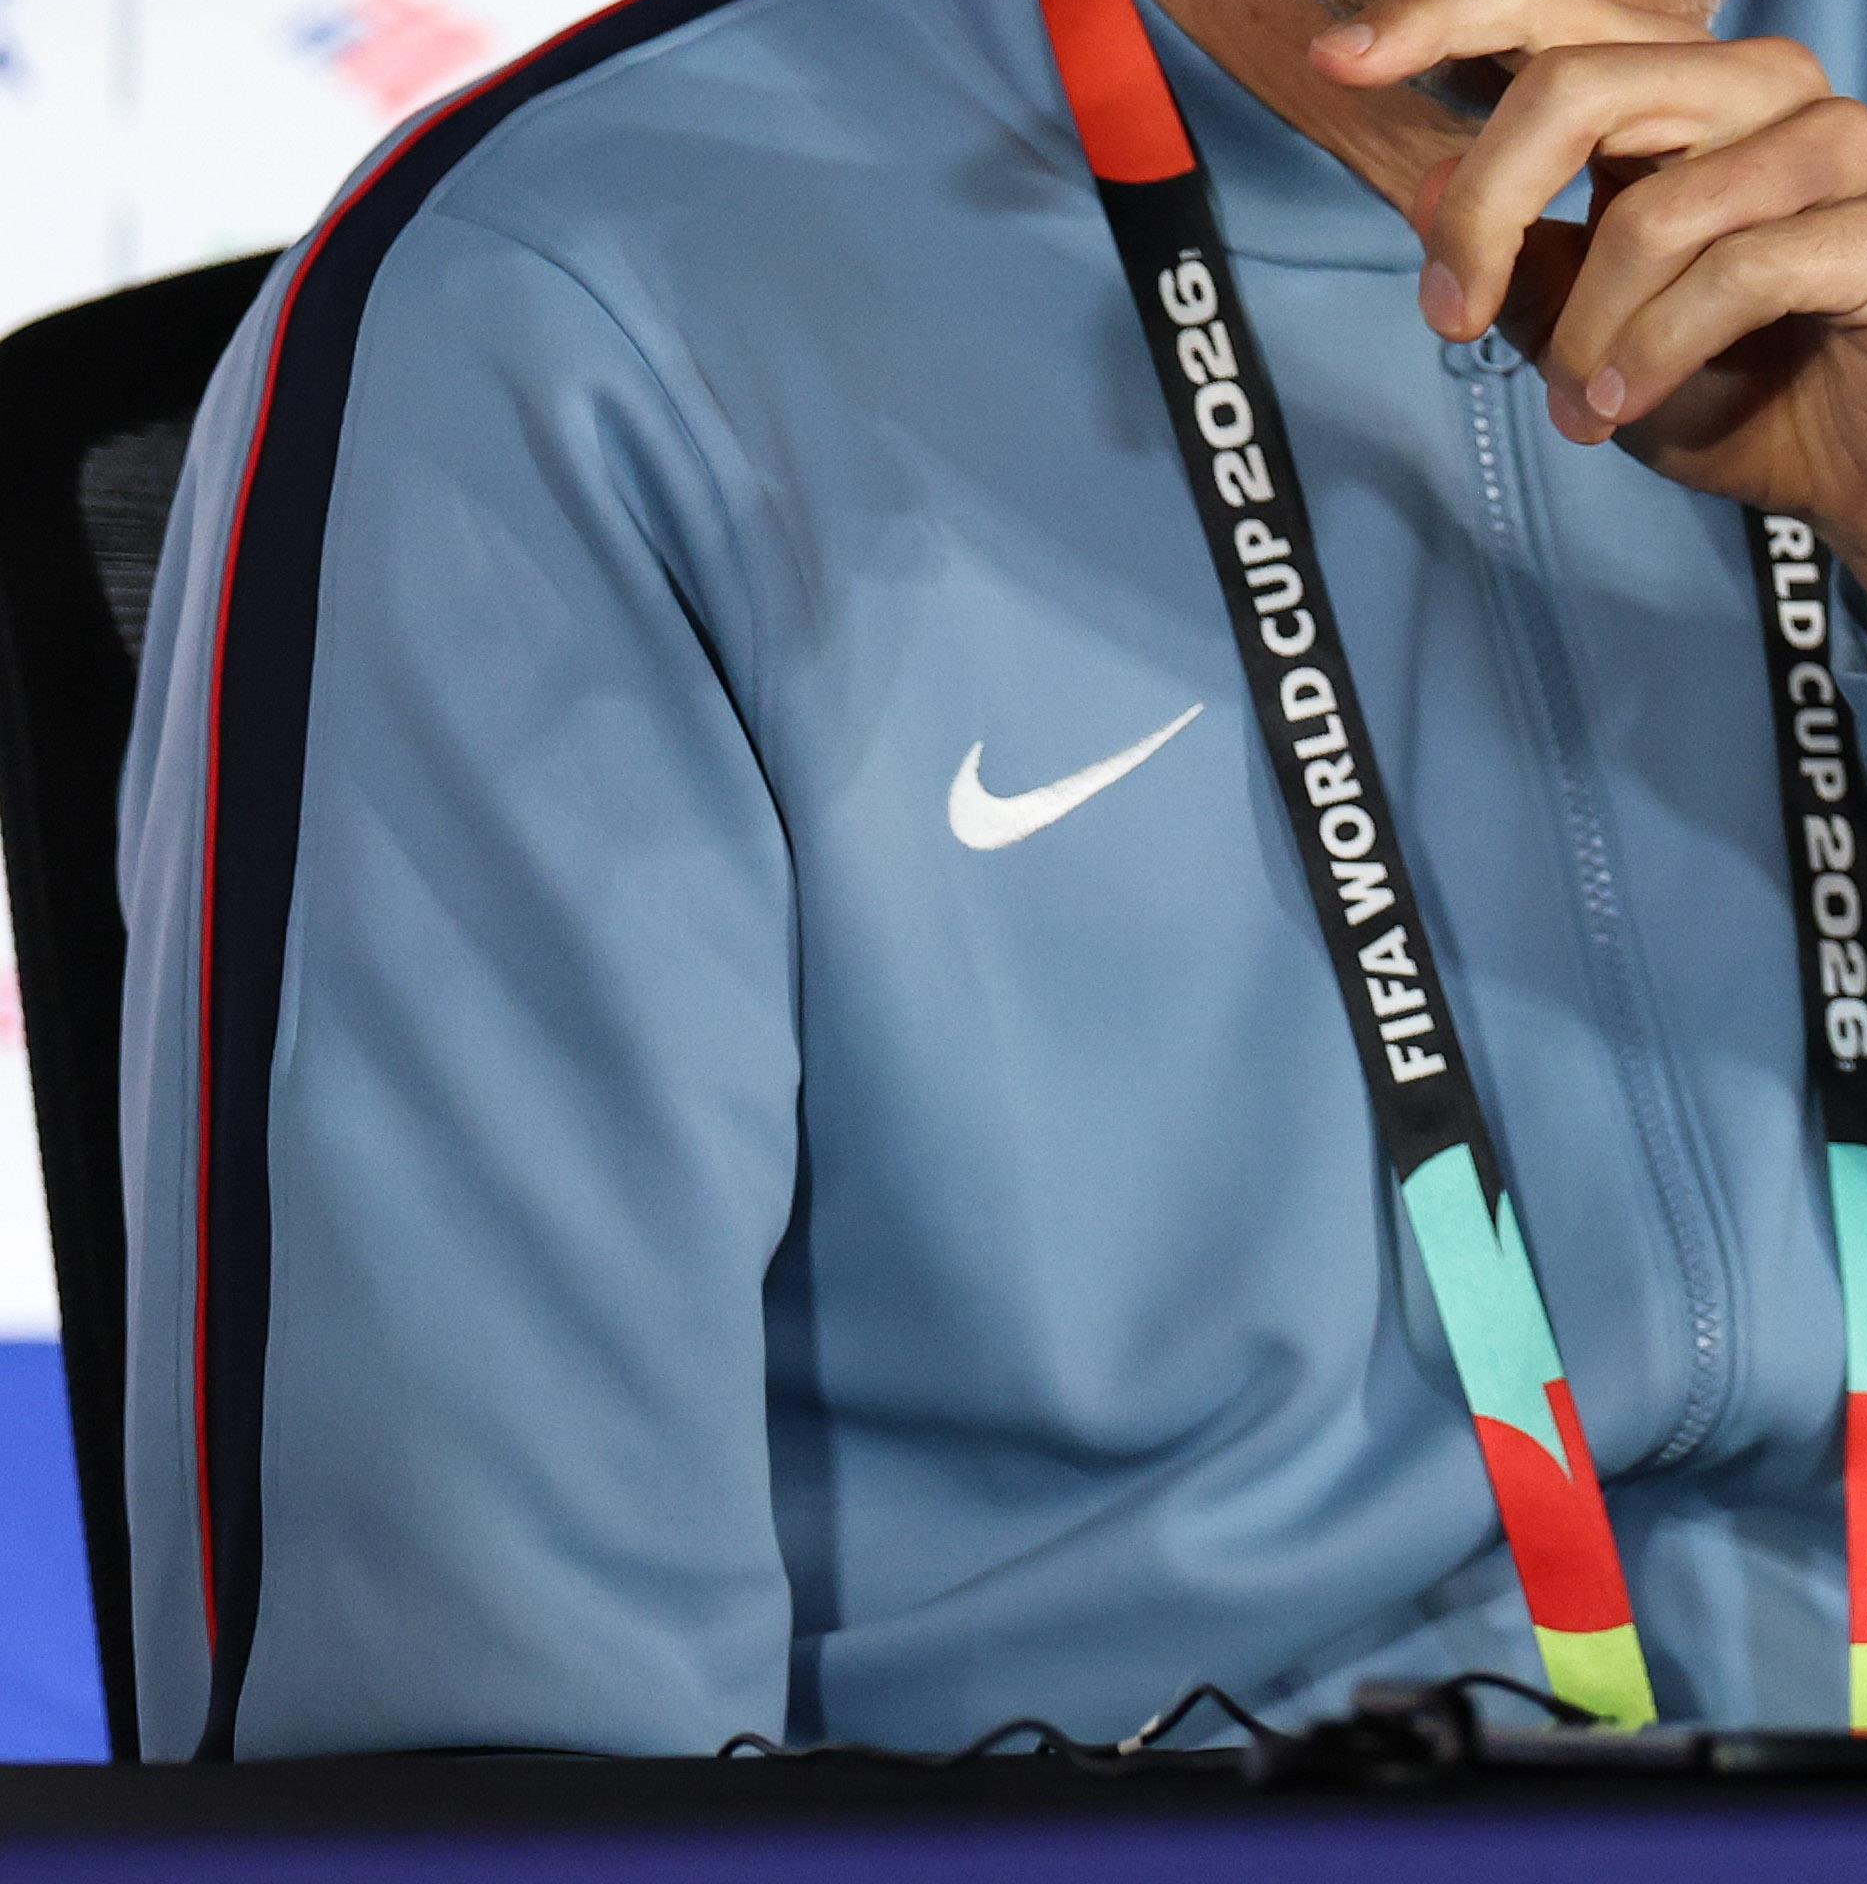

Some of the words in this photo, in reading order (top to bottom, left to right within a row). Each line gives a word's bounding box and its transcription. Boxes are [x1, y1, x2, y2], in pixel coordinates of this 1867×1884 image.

[1157, 259, 1276, 508] 2026
[1233, 517, 1317, 657] CUP
[1763, 514, 1827, 651] RLD
[1279, 666, 1399, 927] WORLD
[1787, 661, 1848, 803] CUP
[1353, 923, 1449, 1084] FIFA
